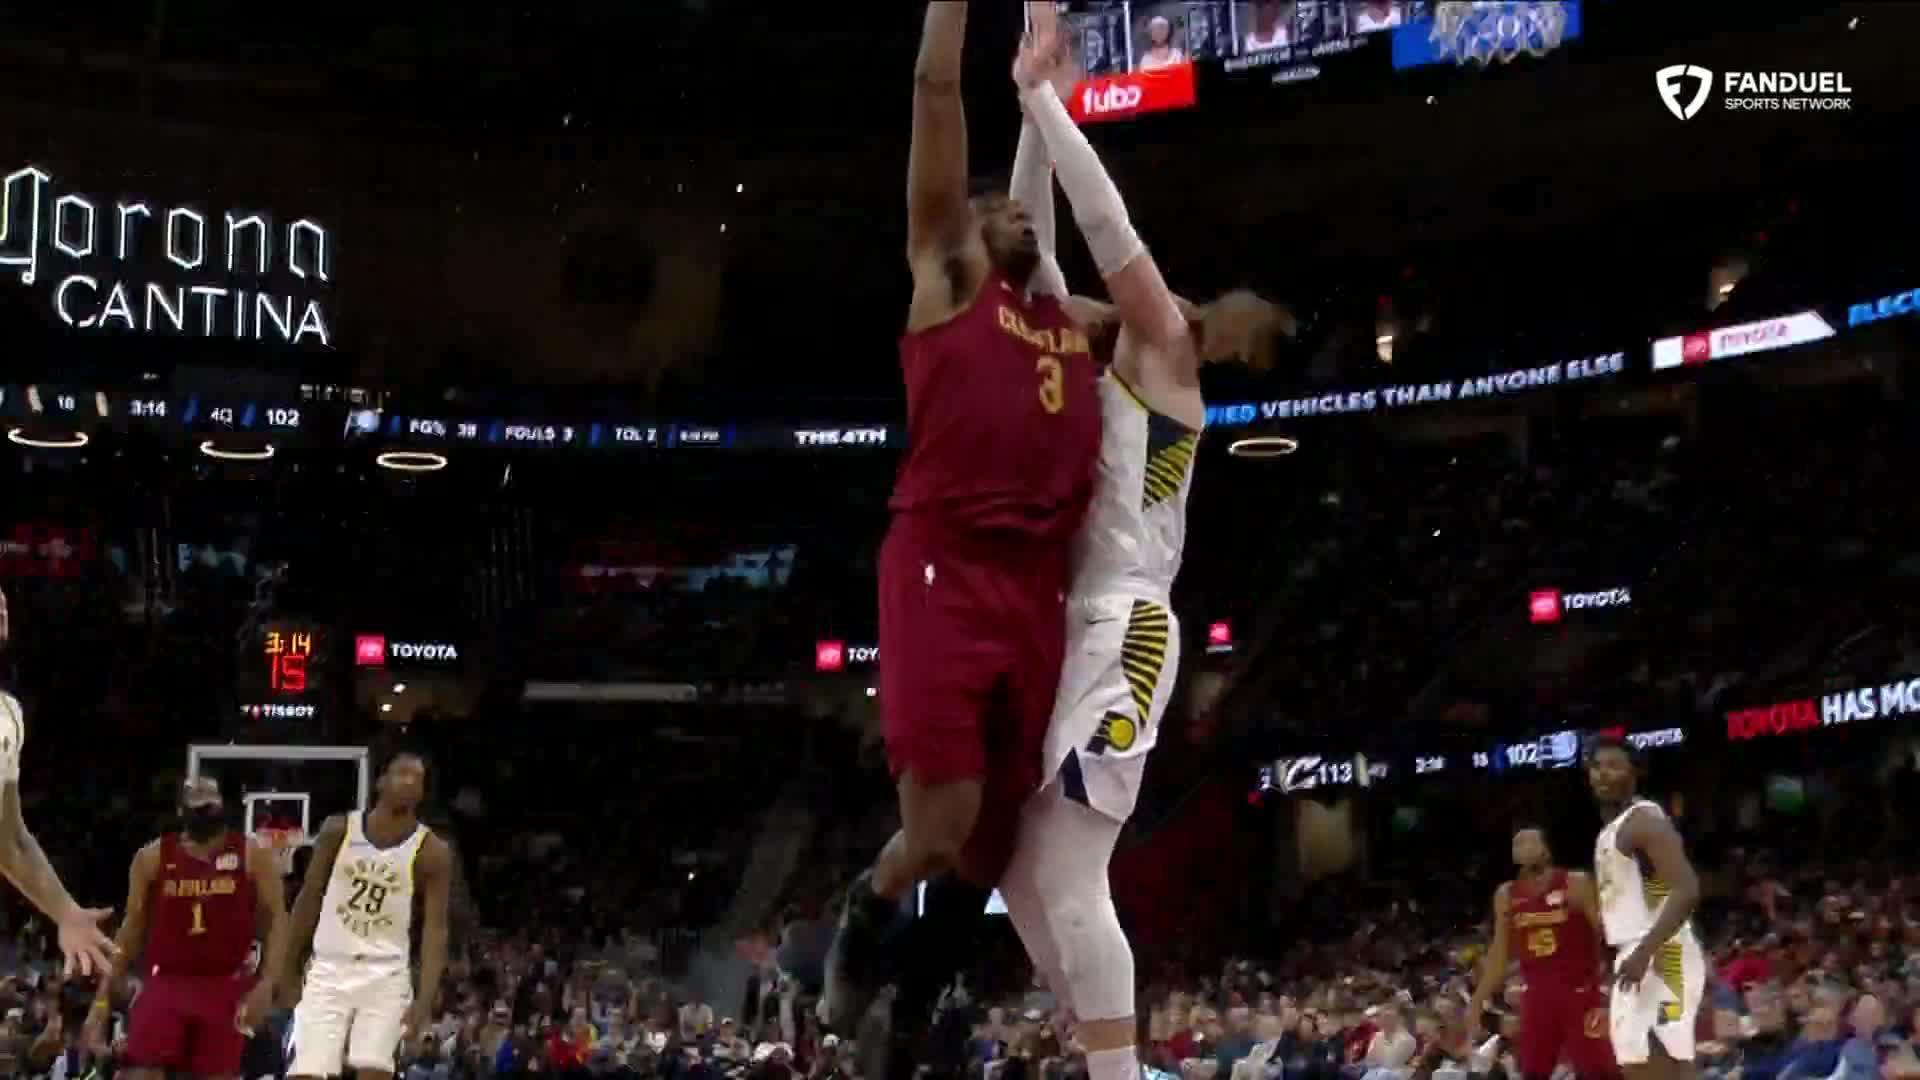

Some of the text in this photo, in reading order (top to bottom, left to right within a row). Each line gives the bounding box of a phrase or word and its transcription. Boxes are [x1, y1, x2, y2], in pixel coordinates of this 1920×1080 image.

[56, 275, 330, 345] CANTINA
[1037, 355, 1063, 414] 3
[1262, 391, 1377, 419] VEHICLES
[1382, 380, 1451, 406] THAN
[1458, 360, 1562, 399] ANYONE
[1567, 352, 1625, 379] ELSE
[266, 409, 300, 427] 102
[1562, 587, 1632, 608] TOYOTA
[264, 632, 311, 655] 3:14
[391, 643, 458, 657] TOYOTA
[847, 647, 880, 662] TOY
[271, 655, 304, 690] 15
[1728, 699, 1821, 740] TOYOTA
[1822, 688, 1876, 726] HAS
[1319, 763, 1353, 785] 113
[349, 877, 386, 915] 29
[189, 903, 208, 936] 1
